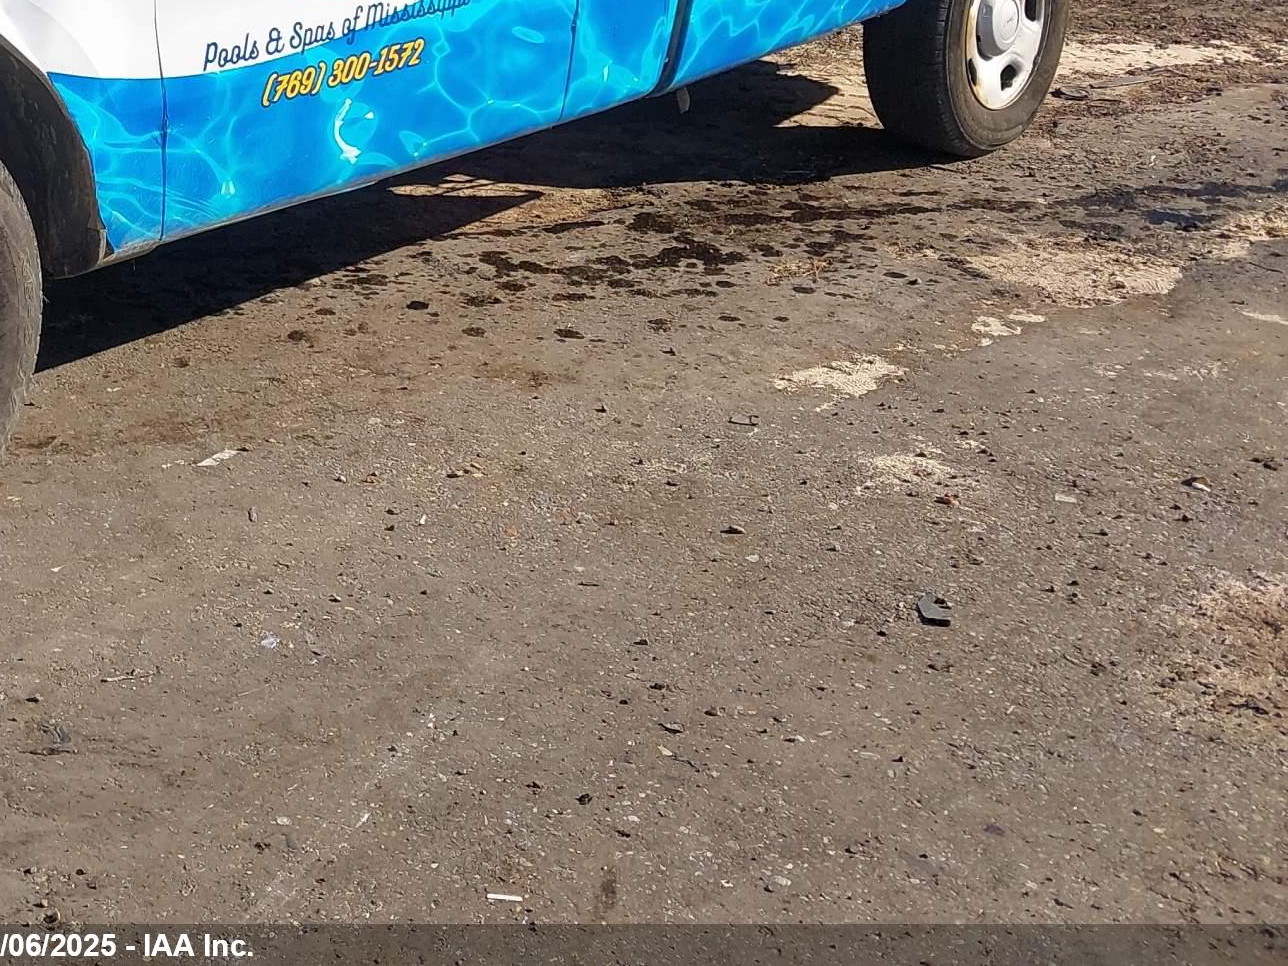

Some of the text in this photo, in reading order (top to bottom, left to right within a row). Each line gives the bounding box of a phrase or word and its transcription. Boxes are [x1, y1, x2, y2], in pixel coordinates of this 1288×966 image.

[203, 32, 259, 70] Pools
[265, 27, 285, 55] &
[289, 20, 335, 55] Spas
[342, 4, 363, 44] of
[261, 39, 425, 107] (769) 300-1572
